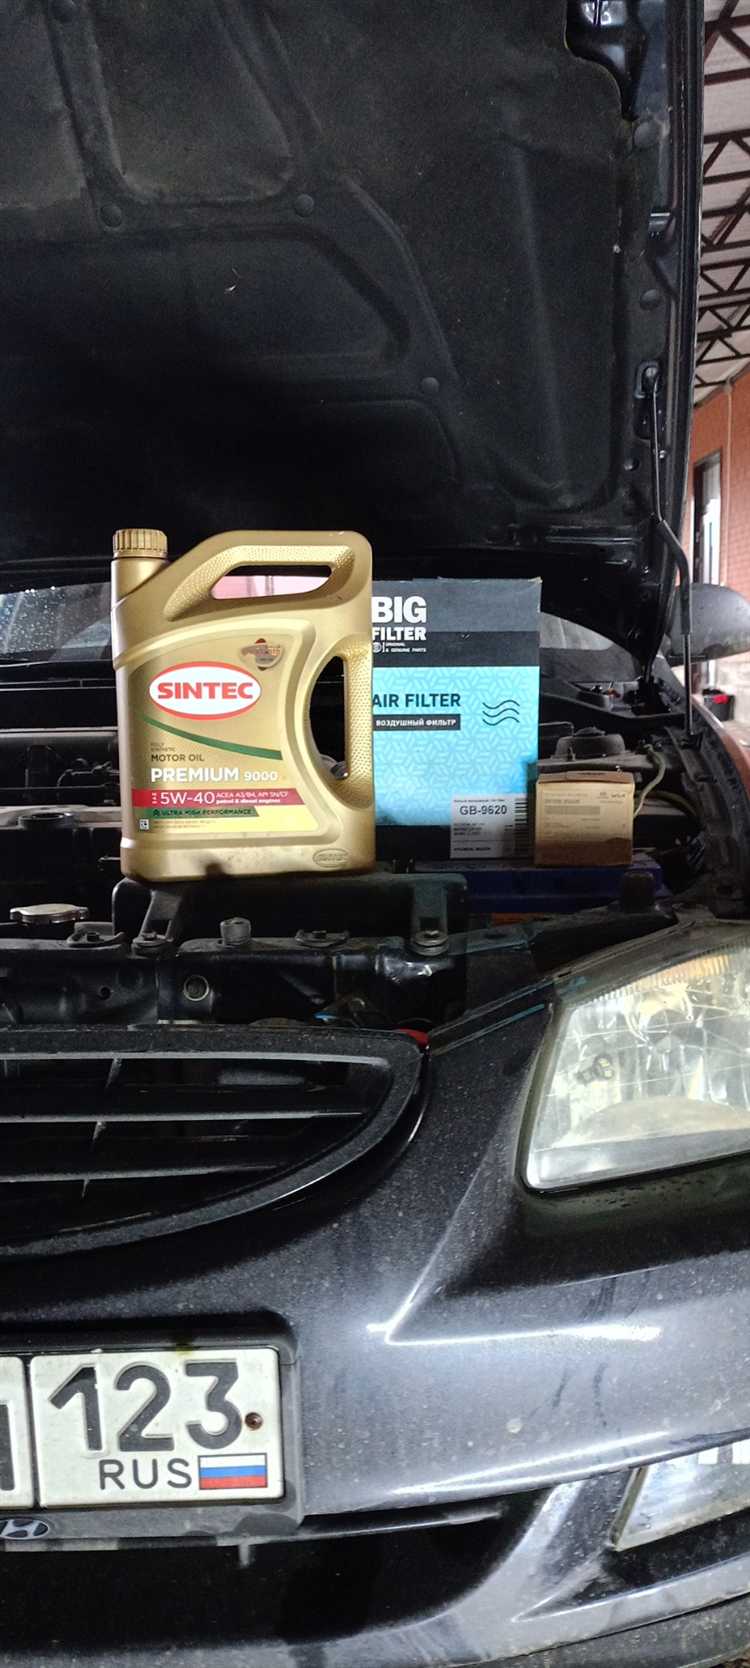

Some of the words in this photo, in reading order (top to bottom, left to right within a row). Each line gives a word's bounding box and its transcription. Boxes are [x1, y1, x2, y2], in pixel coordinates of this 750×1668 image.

[371, 596, 427, 624] BIG
[372, 626, 427, 641] FILTER
[157, 681, 254, 700] SINTEC
[372, 693, 400, 708] AIR
[404, 693, 461, 708] FILTER
[375, 718, 424, 727] ВОЗДУШНЫЙ
[426, 719, 457, 727] ФИЛЬТР
[150, 767, 240, 783] PREMIUM
[243, 770, 278, 782] 9000
[160, 791, 215, 805] 5W-40
[202, 808, 251, 816] PERFORMANCE
[459, 804, 508, 815] GB-9620
[50, 1360, 242, 1452] 123
[99, 1457, 192, 1491] RUS
